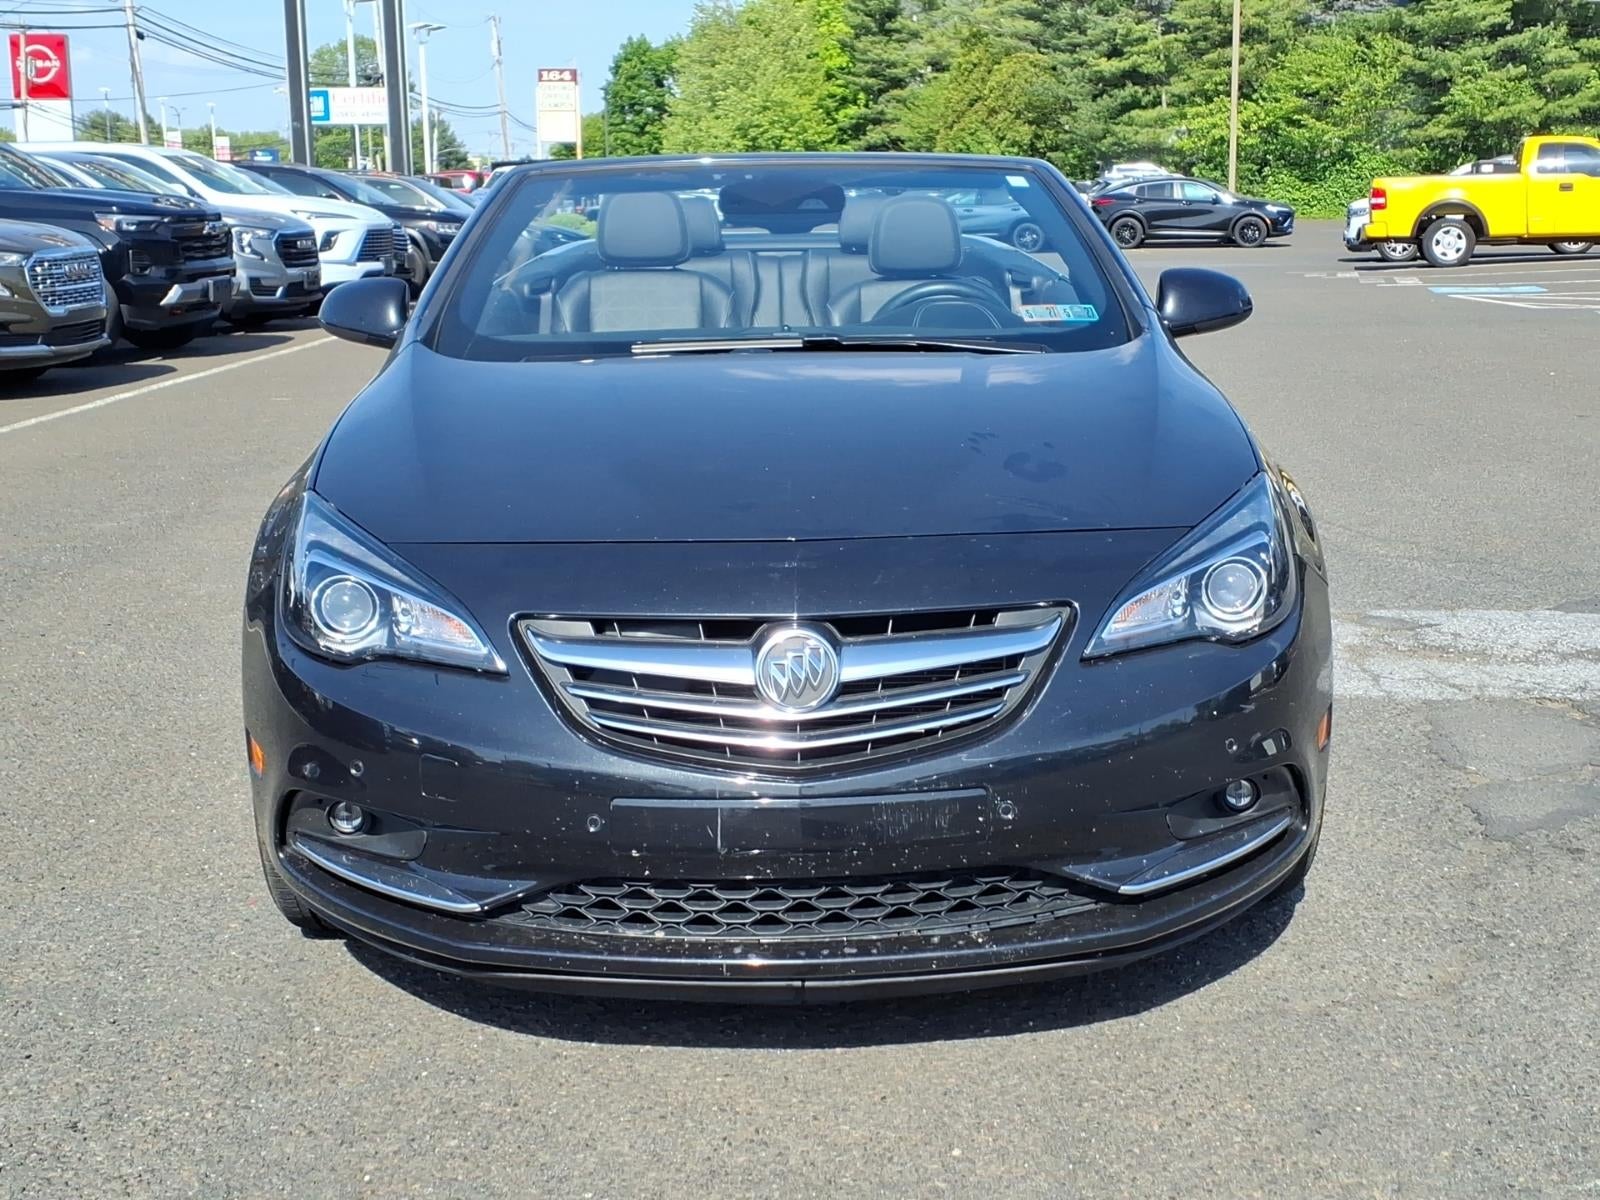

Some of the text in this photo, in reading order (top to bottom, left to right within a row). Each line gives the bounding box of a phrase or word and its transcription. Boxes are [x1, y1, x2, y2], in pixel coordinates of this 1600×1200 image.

[16, 59, 60, 68] NSAN
[541, 70, 572, 81] 164
[332, 90, 387, 104] Certifi
[1025, 309, 1034, 319] 5
[1063, 308, 1072, 318] 5
